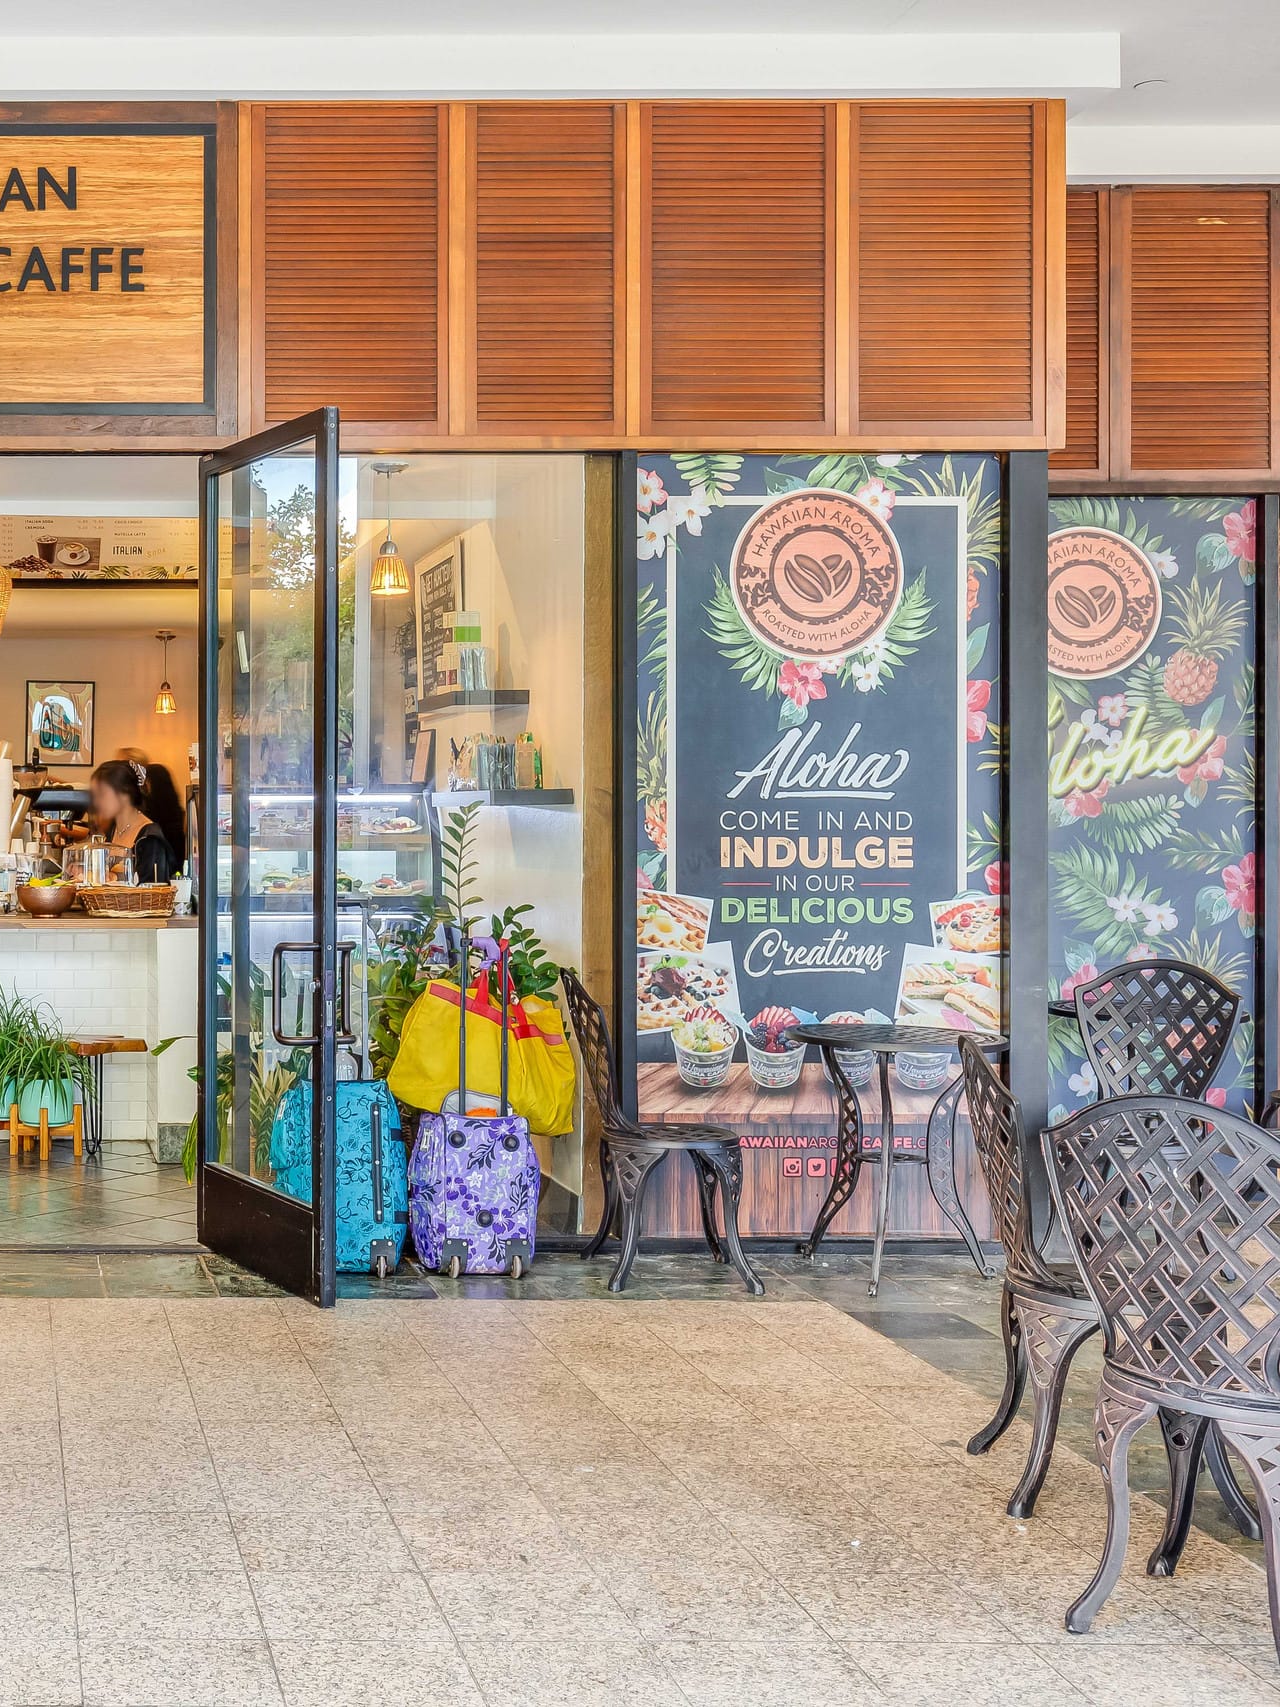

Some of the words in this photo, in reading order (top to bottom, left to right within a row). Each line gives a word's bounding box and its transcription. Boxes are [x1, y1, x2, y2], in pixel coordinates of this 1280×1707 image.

[751, 507, 826, 557] HAWAIIAN
[829, 511, 881, 557] AROMA
[113, 546, 143, 555] ITALIAN
[1096, 546, 1140, 587] AROMA
[762, 608, 805, 640] ROASTED
[808, 631, 838, 642] WITH
[840, 610, 873, 639] ALOHA
[1076, 652, 1104, 662] WITH
[1105, 634, 1133, 659] ALOHA
[726, 721, 911, 799] Aloha
[1048, 695, 1216, 798] loha
[719, 811, 800, 831] COME
[818, 811, 843, 831] IN
[853, 811, 913, 831] AND
[720, 836, 914, 869] INDULGE
[775, 875, 797, 892] IN
[805, 875, 855, 892] OUR
[721, 897, 914, 924] DELICIOUS
[743, 929, 890, 978] Creations
